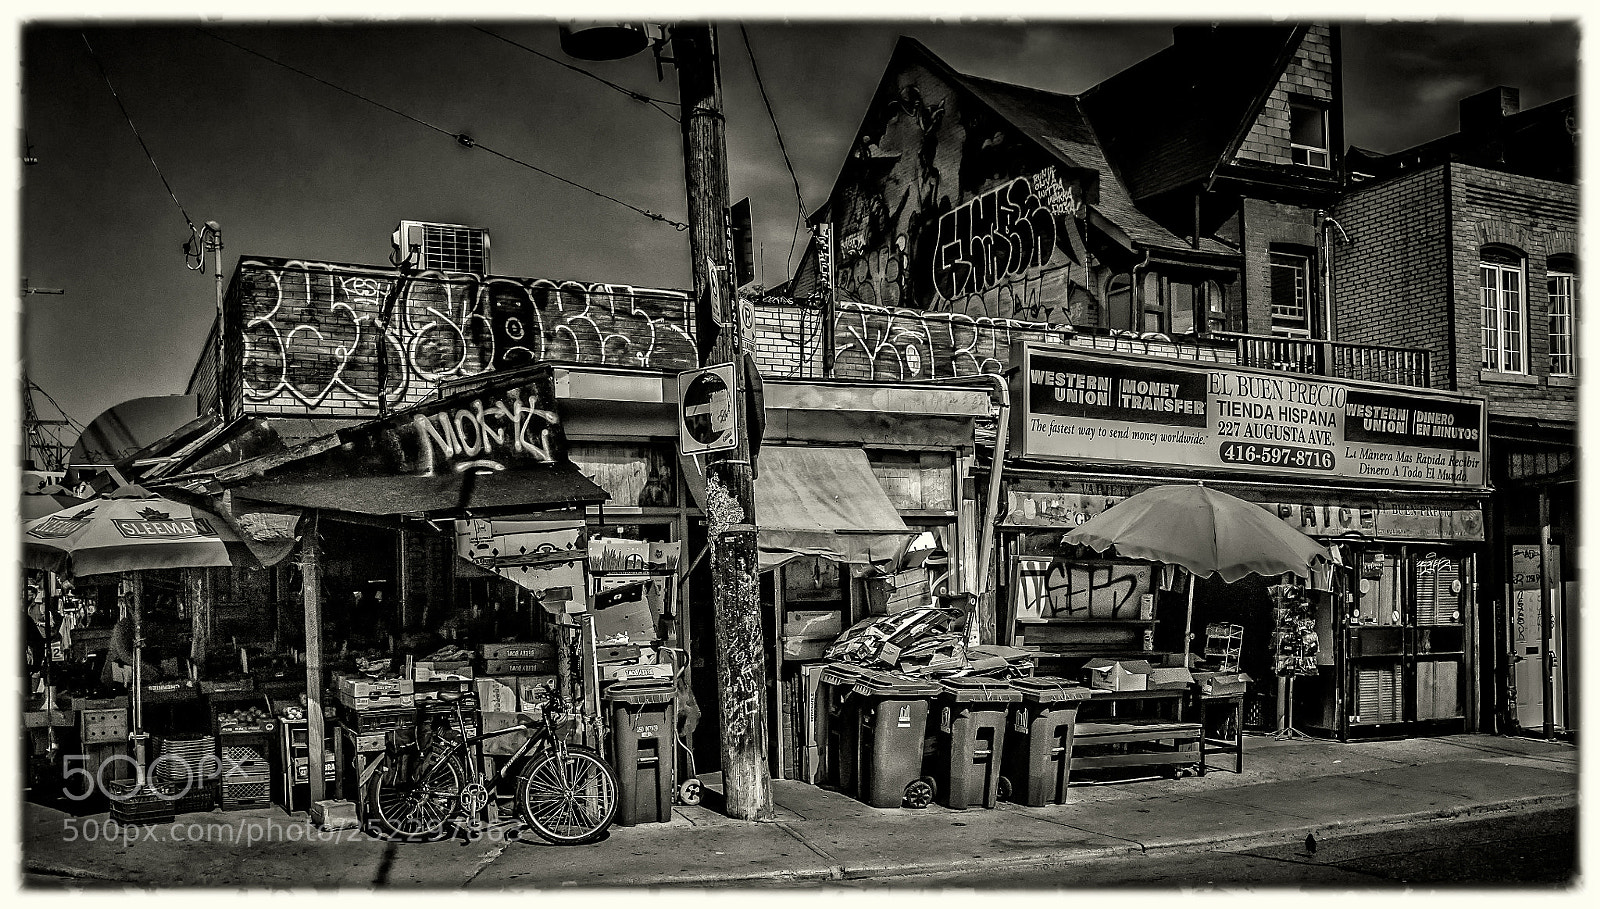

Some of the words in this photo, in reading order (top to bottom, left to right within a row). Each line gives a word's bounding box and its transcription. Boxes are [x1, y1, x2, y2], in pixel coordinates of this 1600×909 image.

[1030, 369, 1109, 390] WESTERN
[1122, 378, 1179, 397] MONEY
[1054, 387, 1109, 406] UNION
[1207, 371, 1233, 396] EL
[1237, 375, 1284, 401] BUEN
[1288, 379, 1347, 408] PRECIO
[1121, 394, 1206, 415] TRANSFER
[1216, 399, 1275, 420] TIENDA
[1278, 405, 1337, 427] HISPANA
[1345, 403, 1406, 422] WESTERN
[1363, 418, 1406, 434] UNION
[1416, 410, 1455, 426] DINERO
[1030, 417, 1048, 433] The
[1047, 419, 1075, 436] fastest
[1078, 426, 1096, 440] way
[1098, 425, 1107, 438] to
[1109, 426, 1129, 439] send
[1131, 431, 1158, 444] money
[1217, 421, 1241, 437] 227
[1243, 423, 1306, 443] AUGUSTA
[1305, 430, 1336, 447] AVE.
[1416, 423, 1431, 436] EN
[1432, 425, 1479, 440] MINUTOS
[1224, 444, 1332, 468] 416-597-8716
[1395, 450, 1413, 463] Mas
[1448, 454, 1480, 468] Recibir
[1359, 462, 1390, 476] Dinero
[1392, 465, 1399, 476] A
[1402, 465, 1423, 478] Todo
[1425, 467, 1435, 479] El
[121, 521, 209, 535] SLEEMAN
